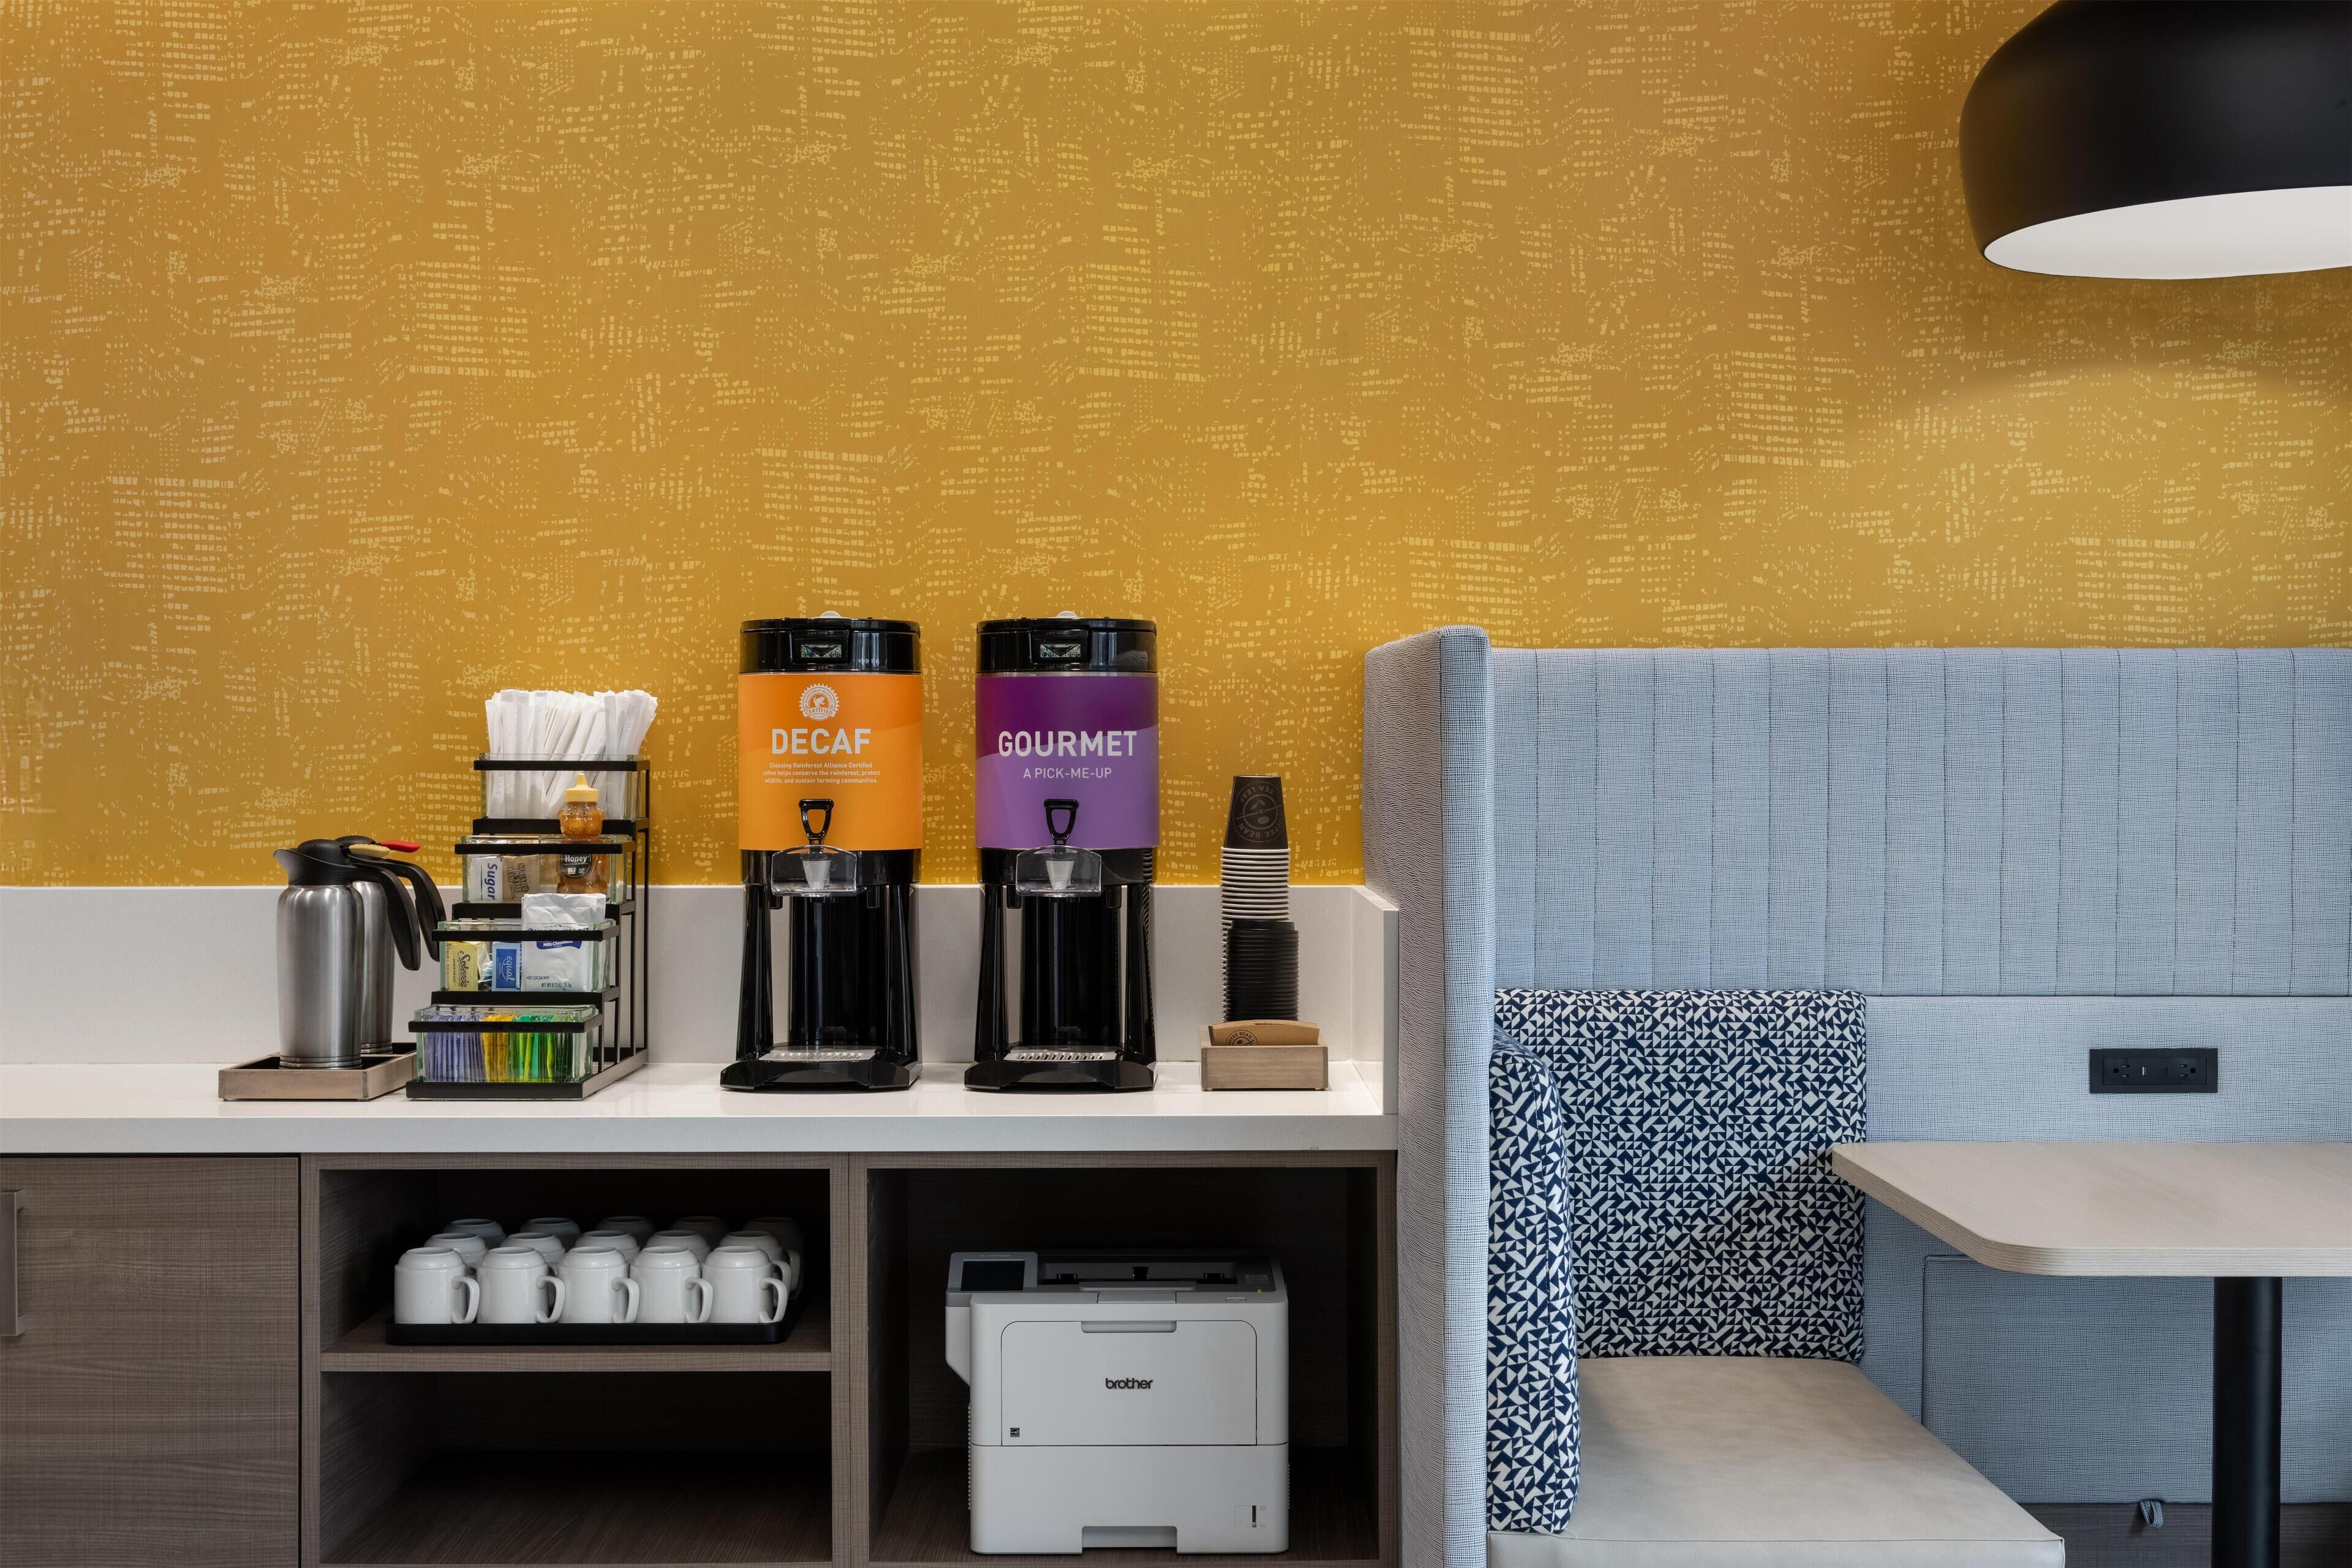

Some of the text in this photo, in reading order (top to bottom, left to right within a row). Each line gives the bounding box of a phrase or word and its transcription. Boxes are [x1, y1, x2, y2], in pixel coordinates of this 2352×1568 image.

[772, 728, 871, 754] DECAF
[998, 731, 1137, 756] GOURMET
[1023, 767, 1112, 778] A PICK-ME-UP
[1240, 785, 1275, 803] TEA LEAF
[1238, 823, 1261, 839] BEAN
[565, 854, 587, 864] Honey
[484, 863, 497, 900] Sugar
[518, 862, 527, 888] SUGAR
[503, 956, 515, 982] equal
[1105, 1378, 1153, 1389] brother
